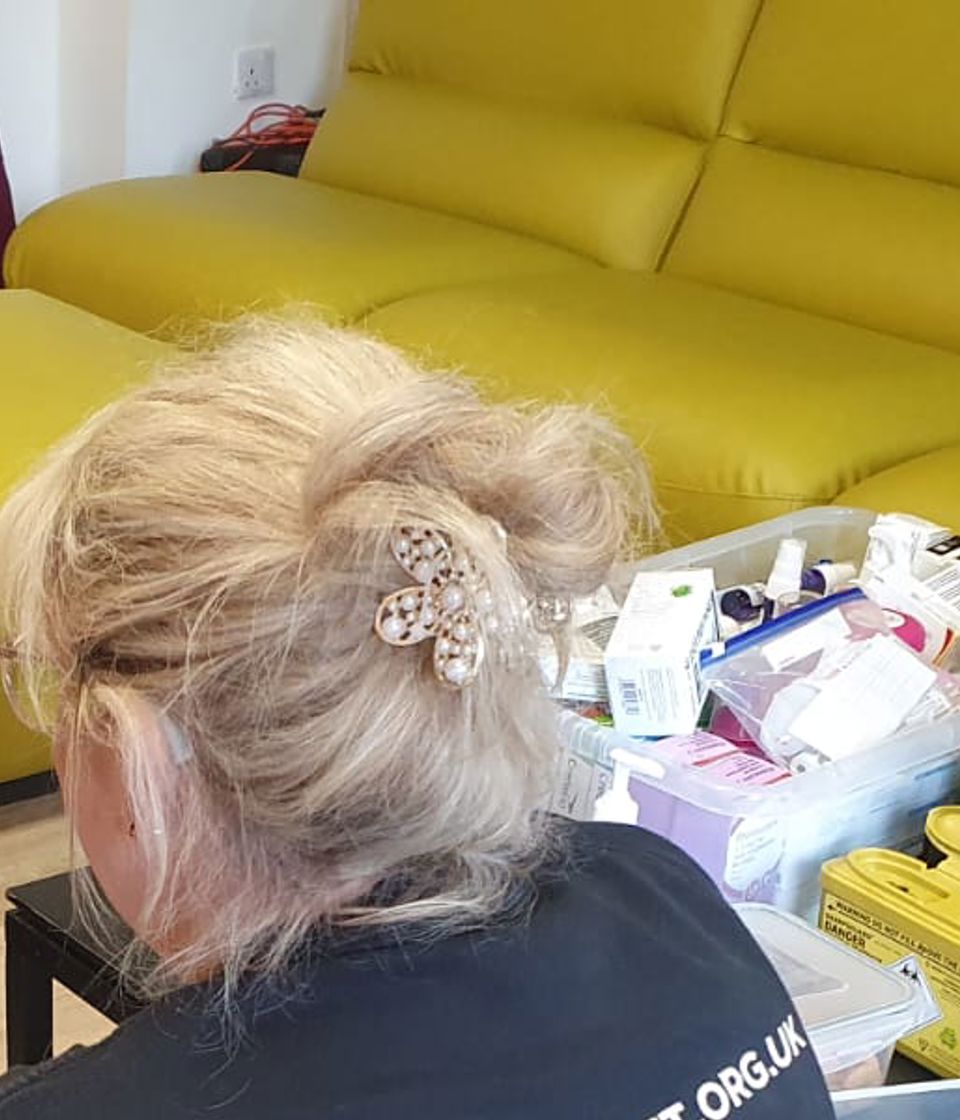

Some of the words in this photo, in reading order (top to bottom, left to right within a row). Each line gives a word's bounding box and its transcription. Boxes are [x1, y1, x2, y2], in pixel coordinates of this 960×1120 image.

[825, 920, 866, 949] DANGER
[836, 901, 871, 923] WARNING
[884, 925, 900, 937] NOT
